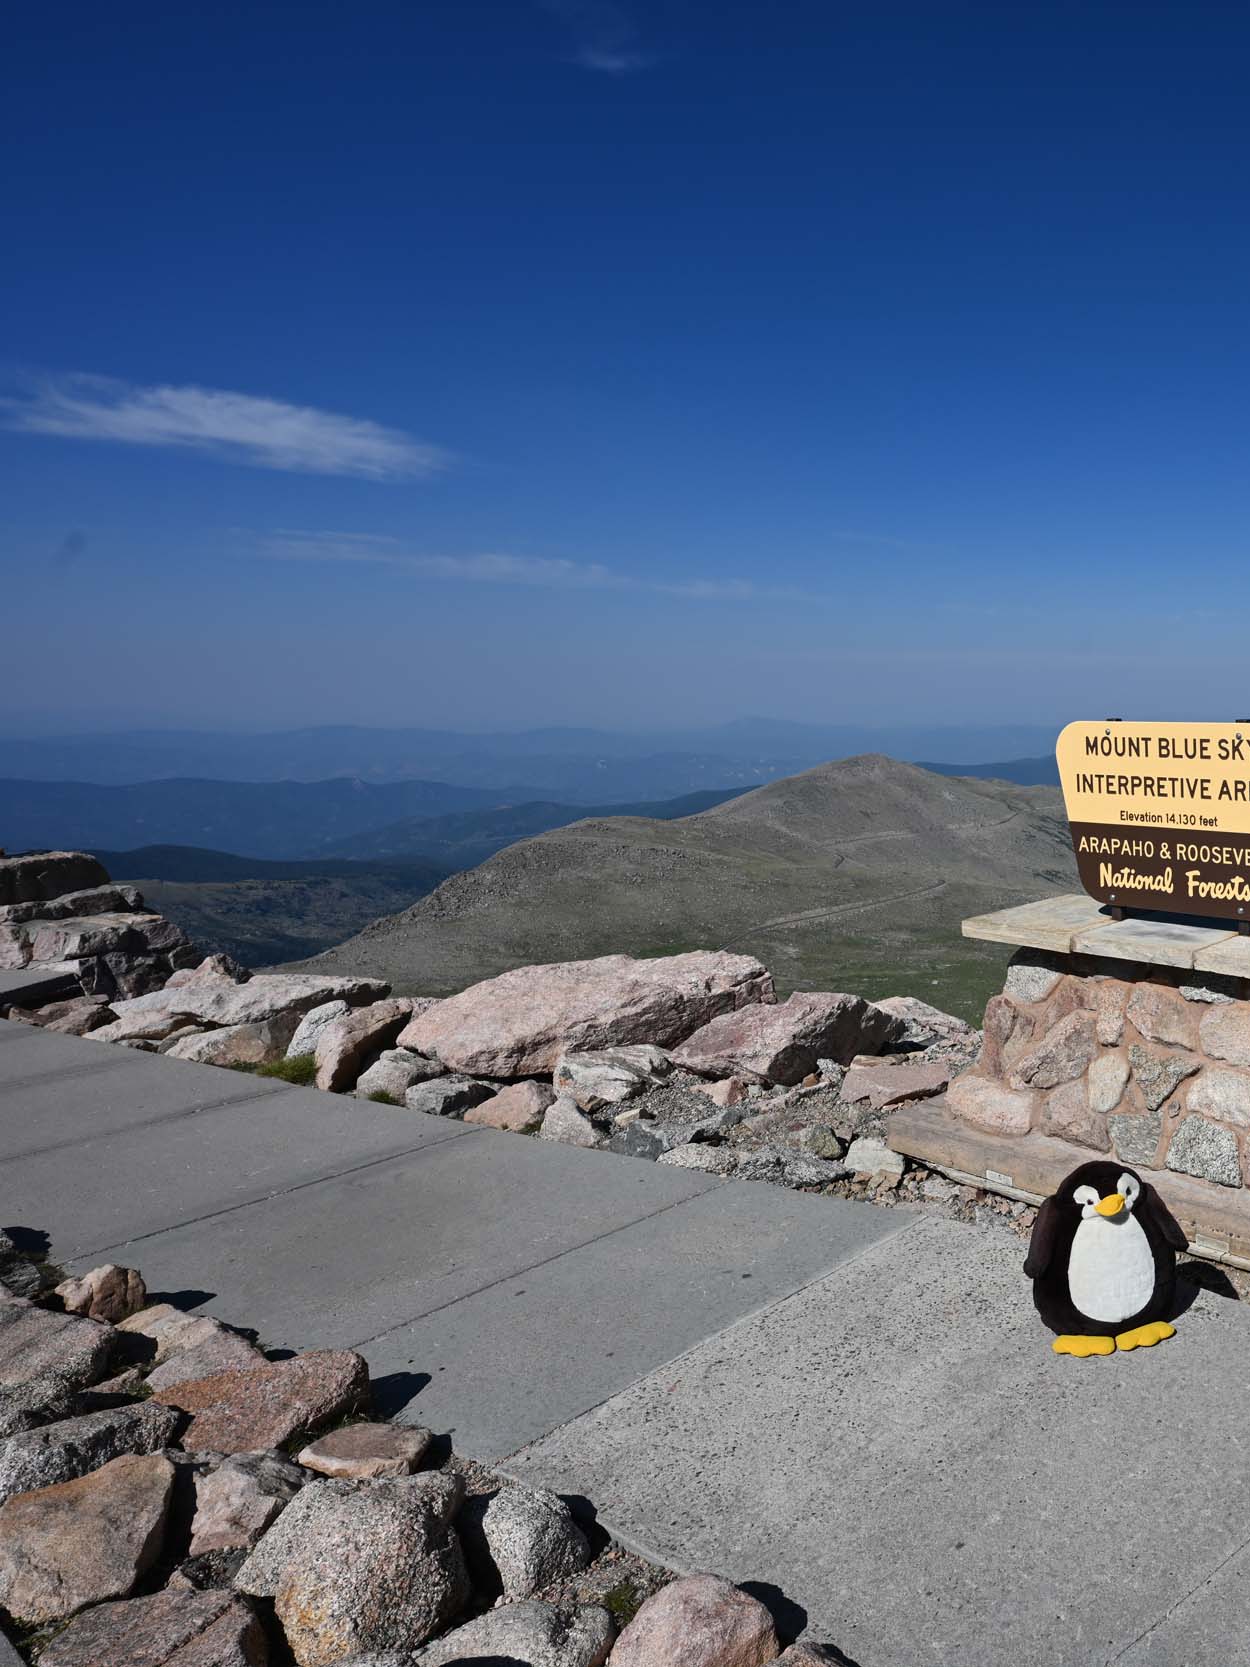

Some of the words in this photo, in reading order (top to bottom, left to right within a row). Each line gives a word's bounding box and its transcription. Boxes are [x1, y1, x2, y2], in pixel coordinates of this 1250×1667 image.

[1085, 736, 1151, 758] MOUNT
[1158, 738, 1211, 759] BLUE
[1076, 774, 1212, 799] INTERPRETIVE
[1120, 810, 1163, 823] Elevation
[1199, 816, 1218, 827] feet
[1079, 837, 1154, 857] ARAPAHO
[1160, 843, 1171, 859] &
[1100, 863, 1173, 894] National
